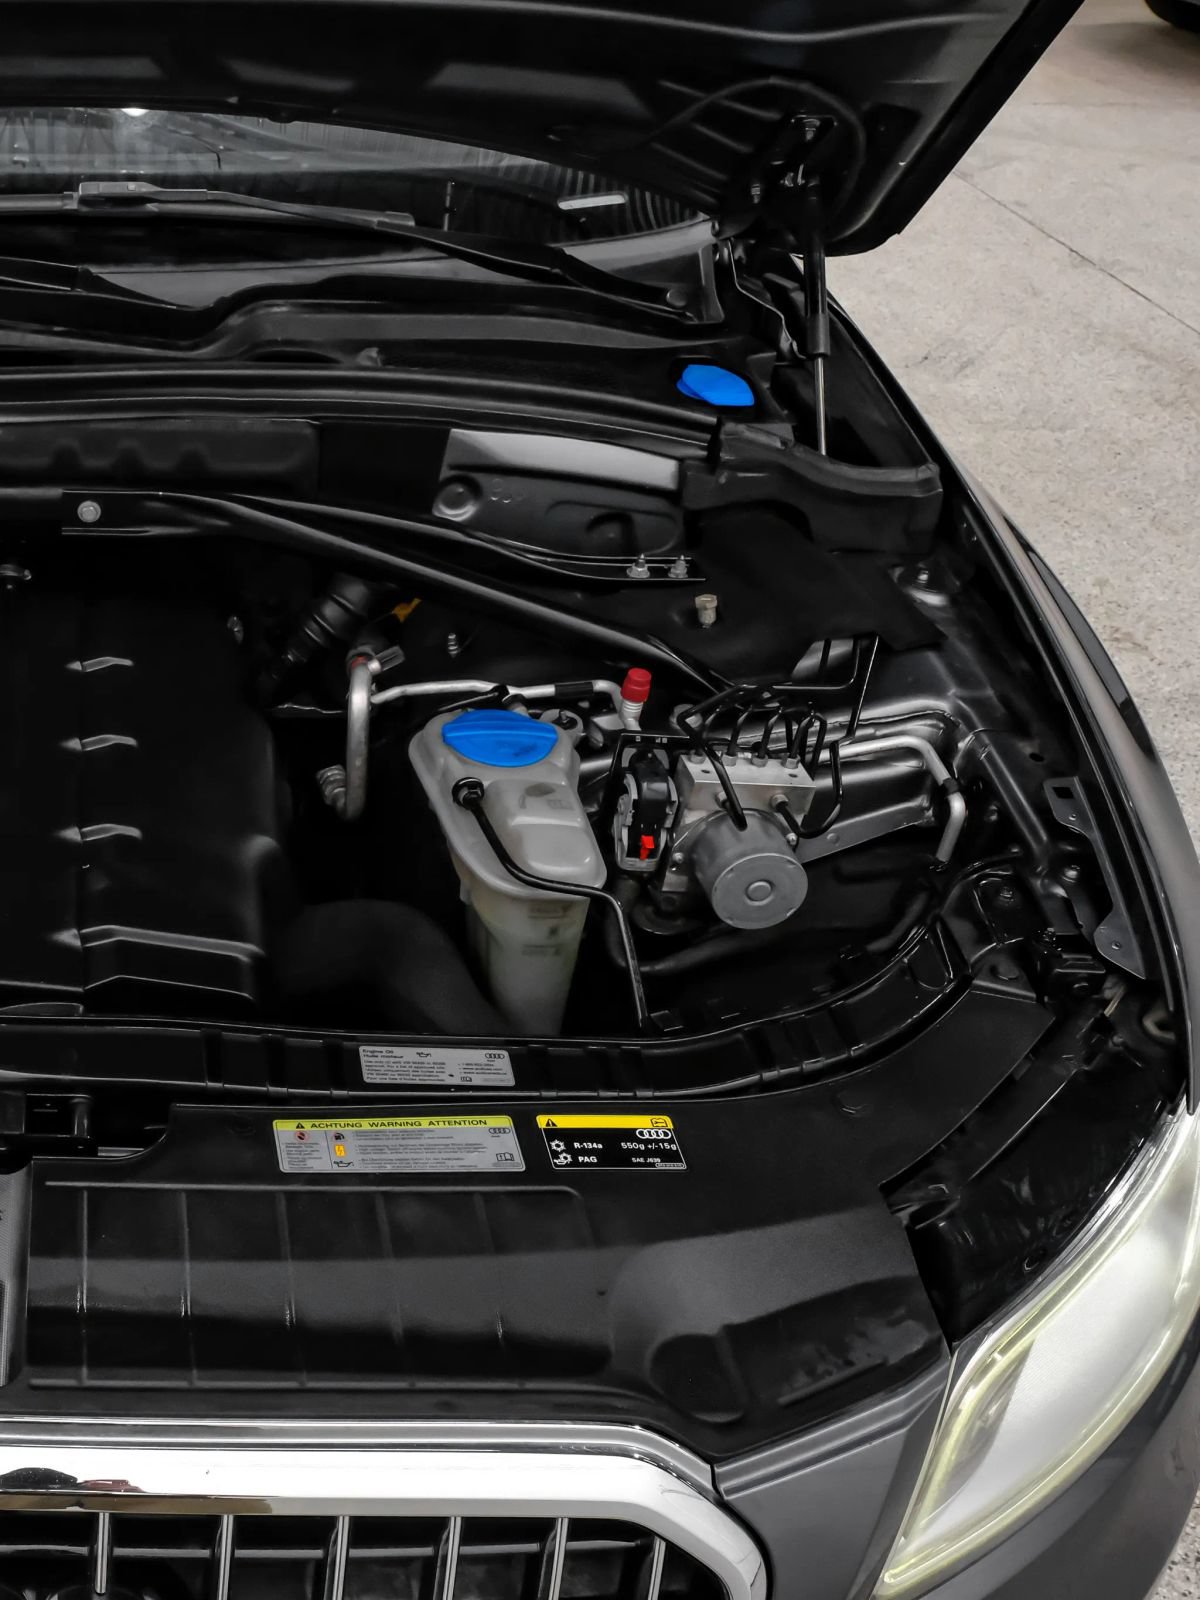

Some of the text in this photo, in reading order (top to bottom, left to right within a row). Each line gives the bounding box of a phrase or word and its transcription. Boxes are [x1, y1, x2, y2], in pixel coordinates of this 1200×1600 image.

[428, 1119, 488, 1127] ATTENTION
[573, 1142, 603, 1150] R-134a
[620, 1142, 645, 1151] 550g
